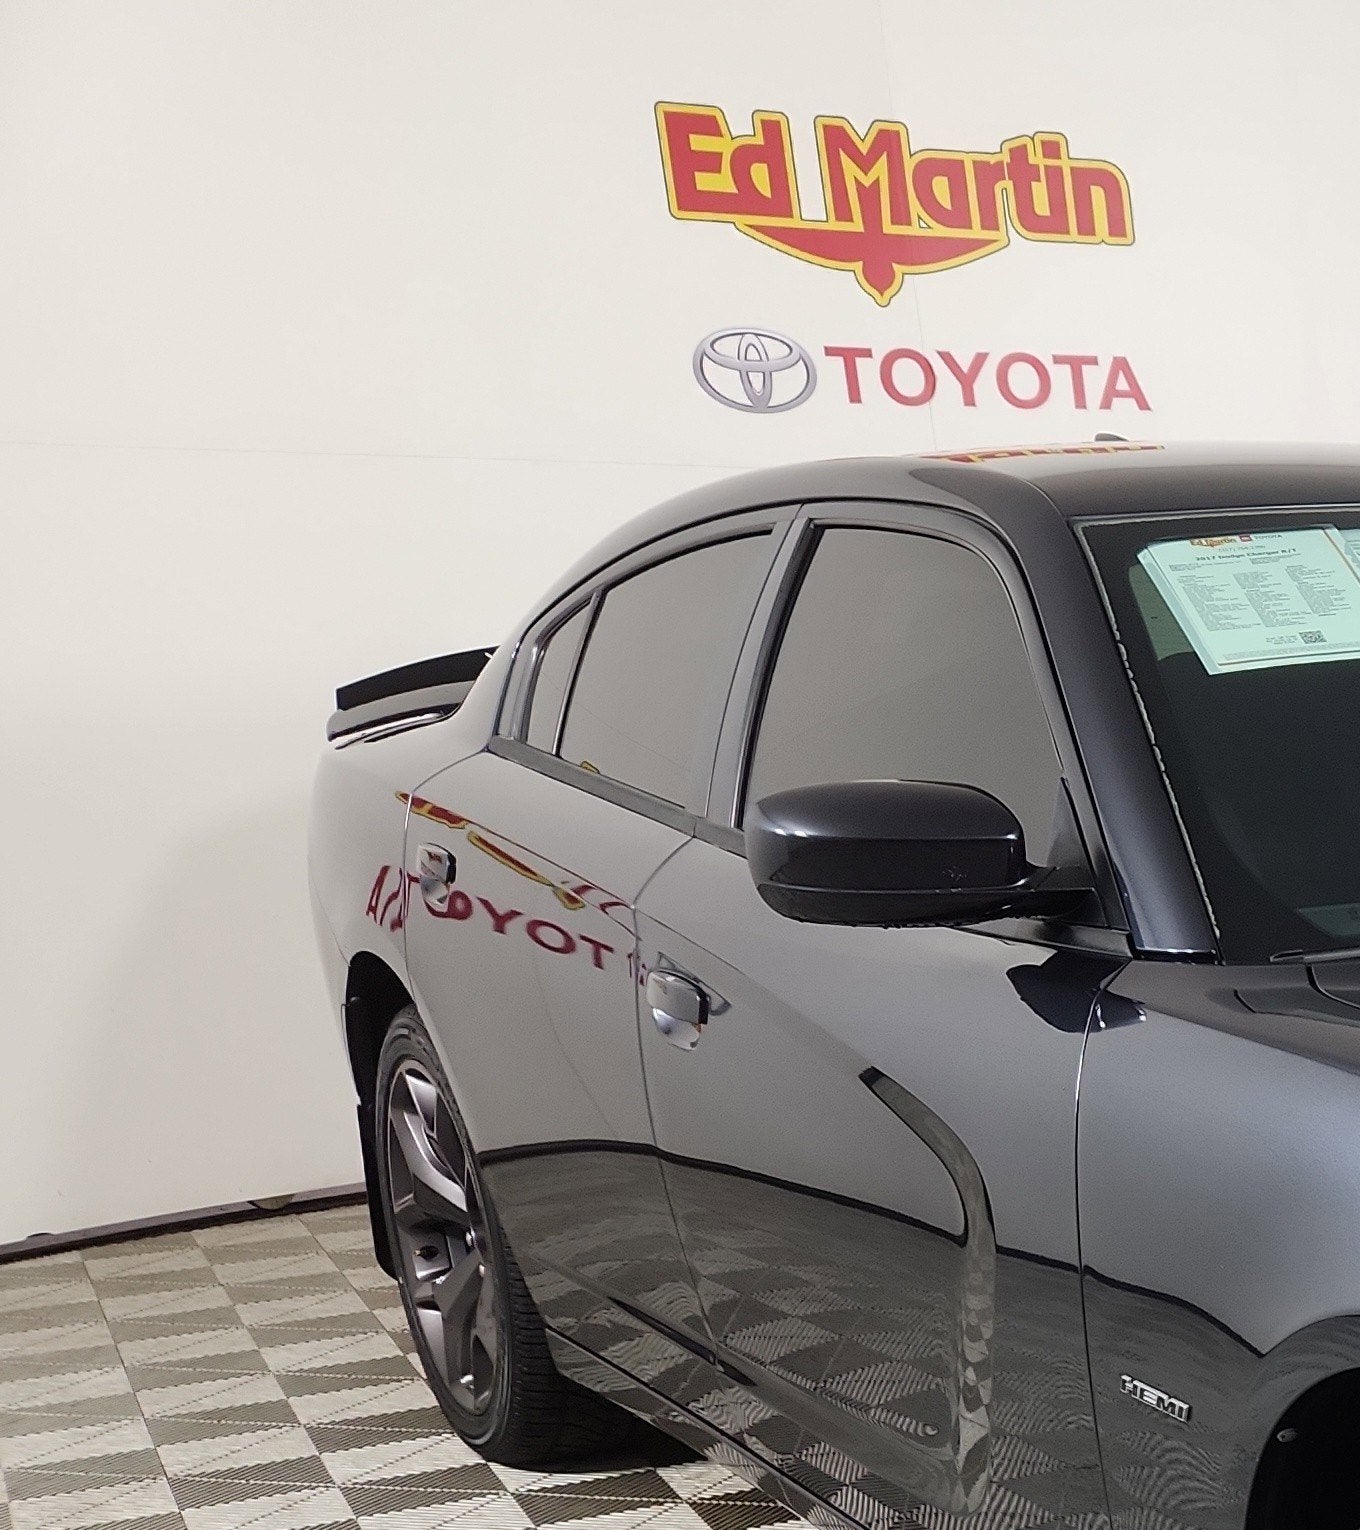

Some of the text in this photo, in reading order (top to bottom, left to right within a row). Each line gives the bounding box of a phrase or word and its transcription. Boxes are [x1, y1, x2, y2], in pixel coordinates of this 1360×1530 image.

[655, 101, 1135, 246] Ed Martin
[823, 344, 1153, 411] TOYOTA
[1120, 1374, 1191, 1422] HEMI
